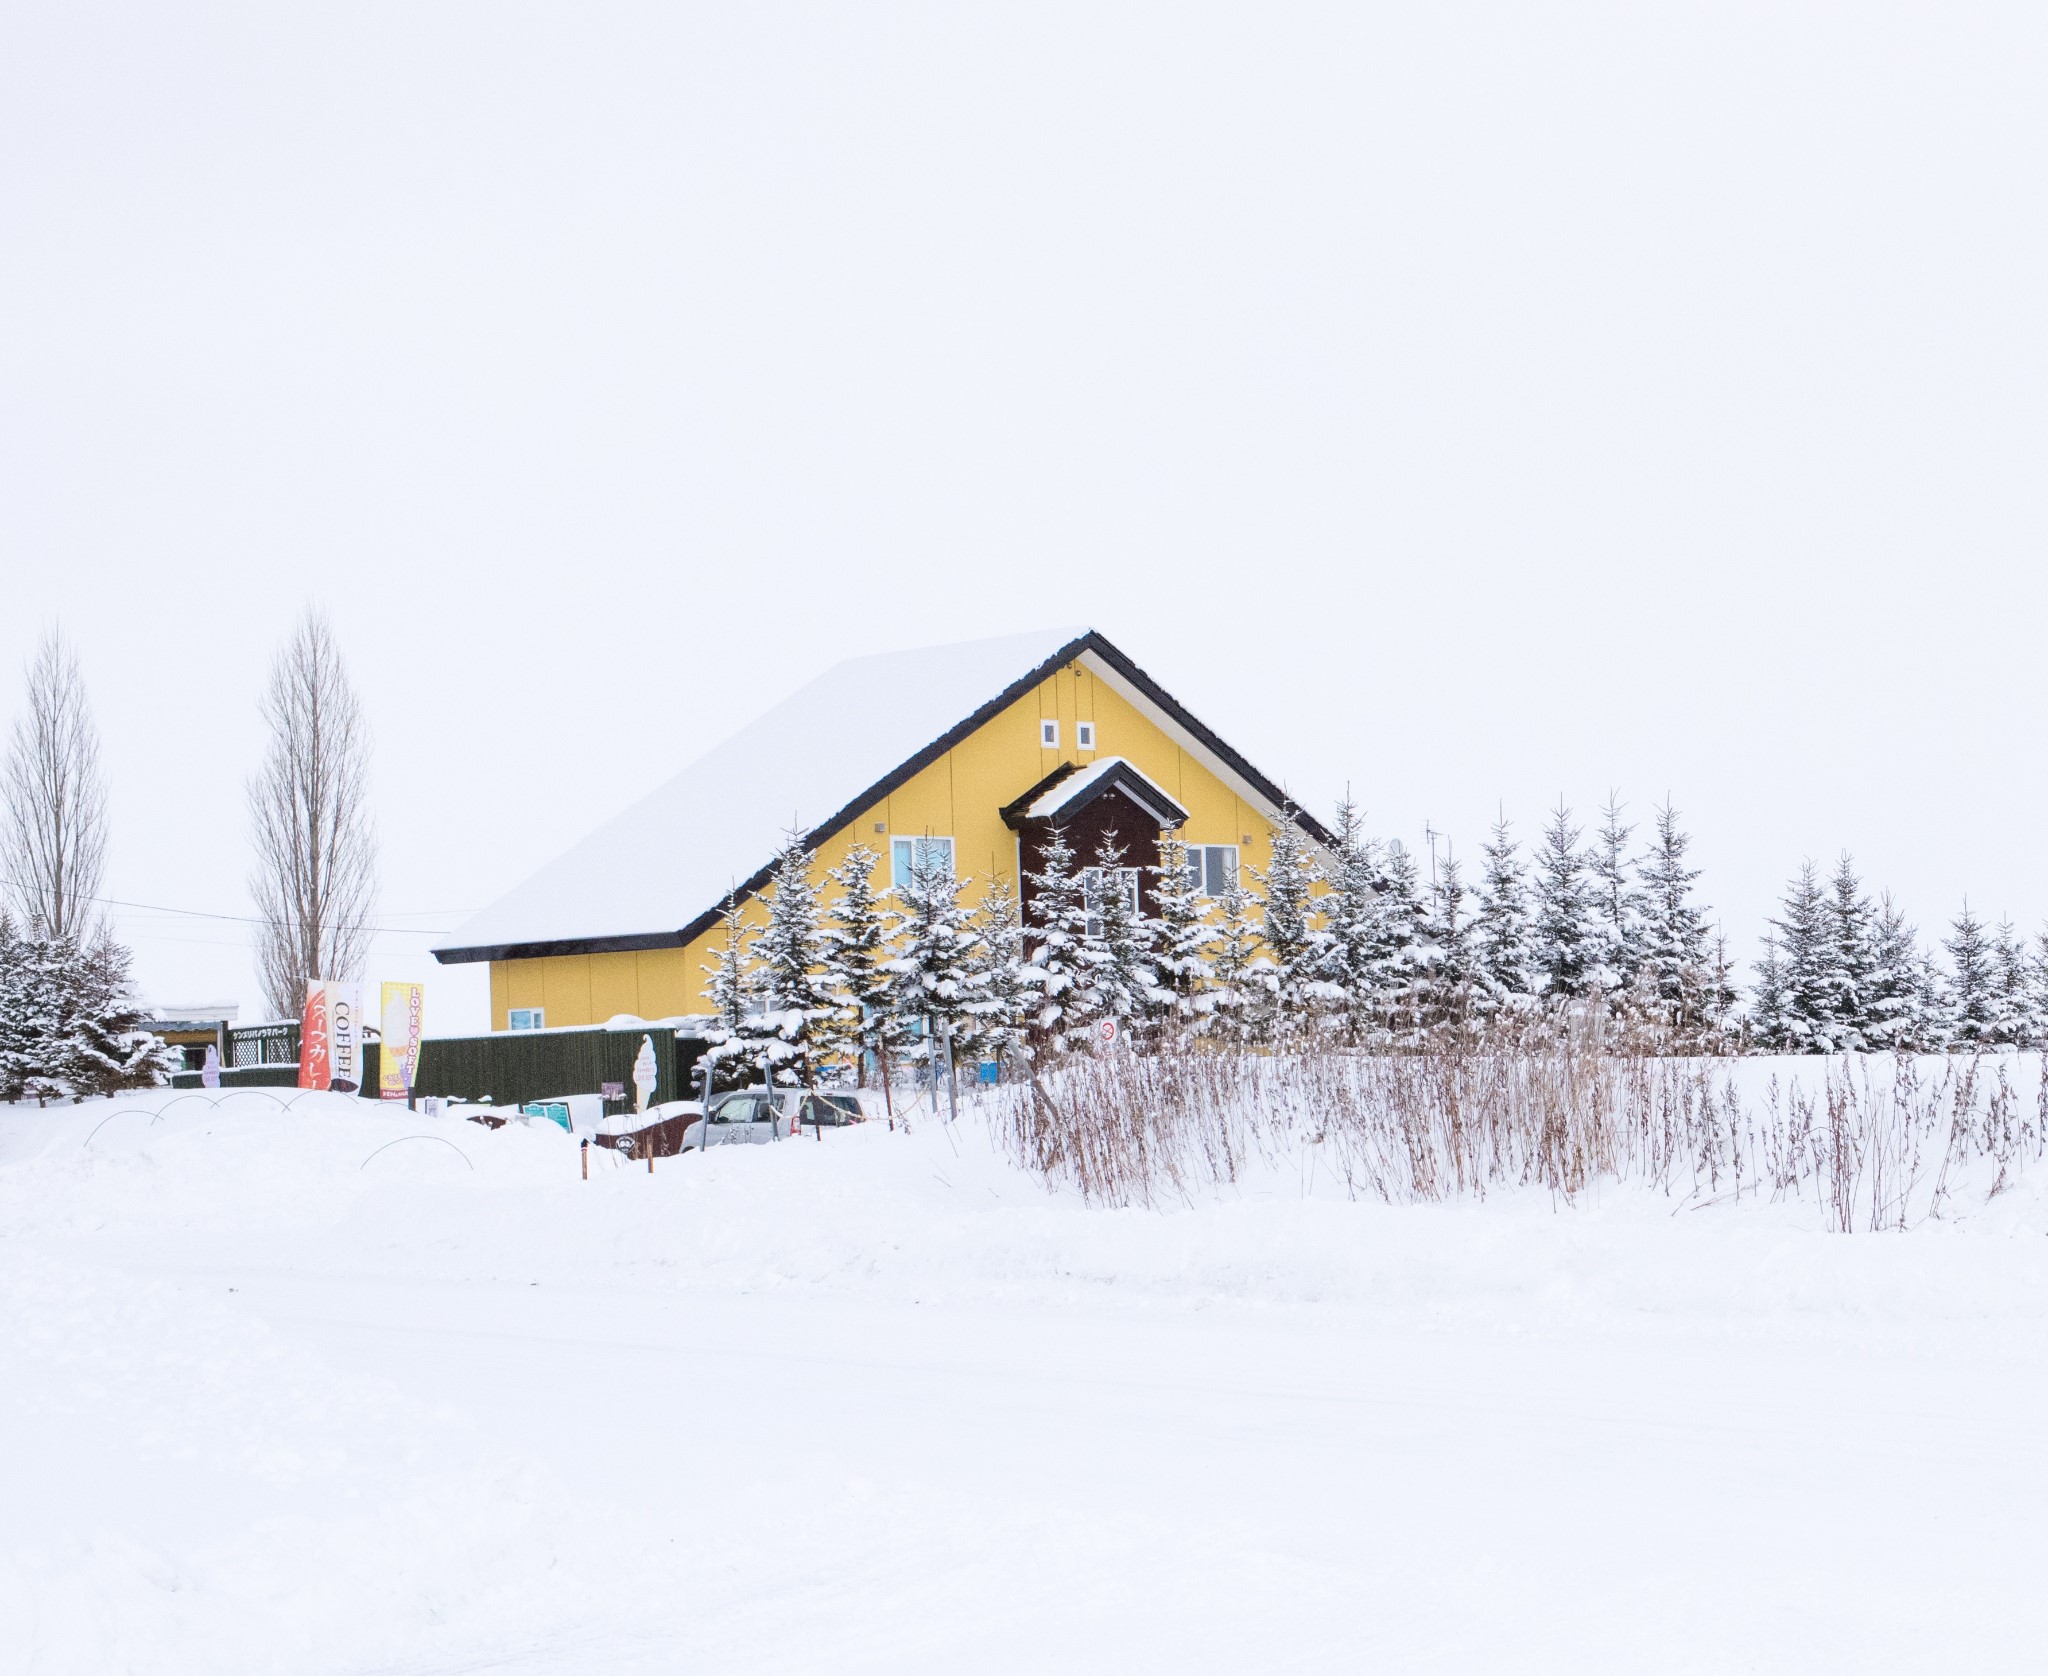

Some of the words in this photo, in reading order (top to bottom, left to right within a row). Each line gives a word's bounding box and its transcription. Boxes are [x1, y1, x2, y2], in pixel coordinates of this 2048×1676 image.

[409, 987, 420, 1026] LOVE
[335, 1002, 351, 1078] COFFEE
[407, 1037, 418, 1074] SOFT
